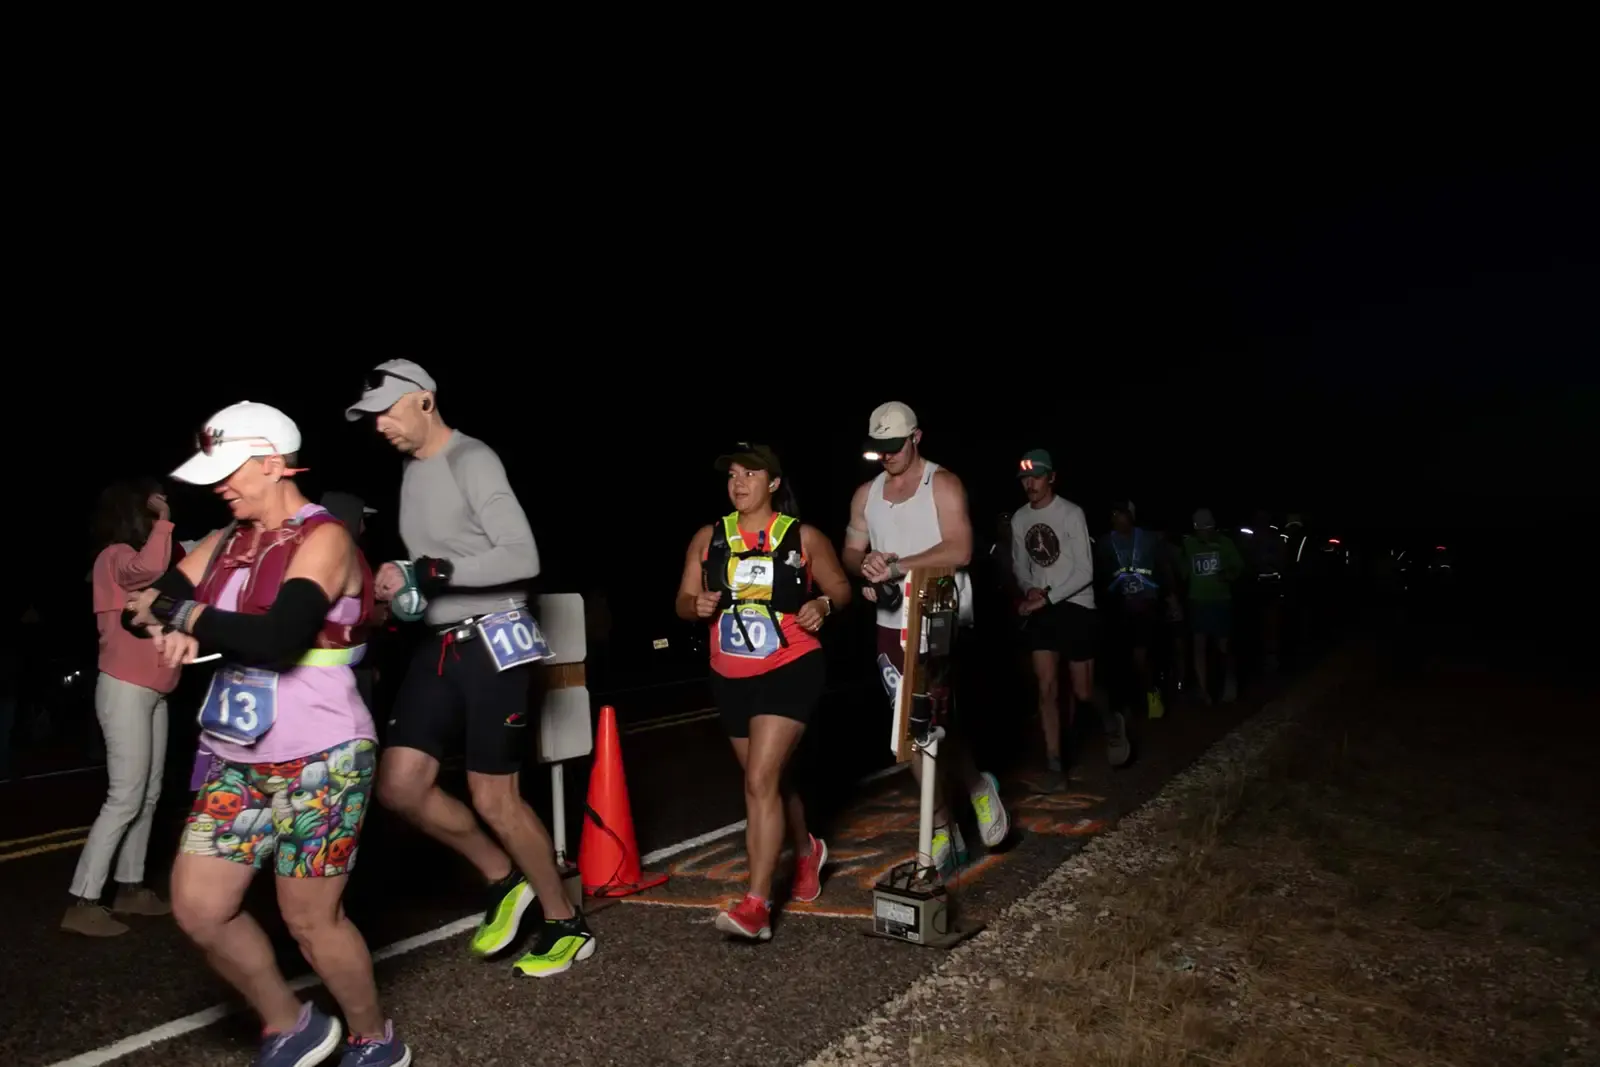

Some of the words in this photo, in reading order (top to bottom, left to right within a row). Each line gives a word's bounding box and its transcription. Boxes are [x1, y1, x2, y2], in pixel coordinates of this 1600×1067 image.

[1196, 559, 1218, 572] 102
[492, 622, 546, 656] 104
[730, 619, 766, 649] 50
[219, 687, 258, 731] 13
